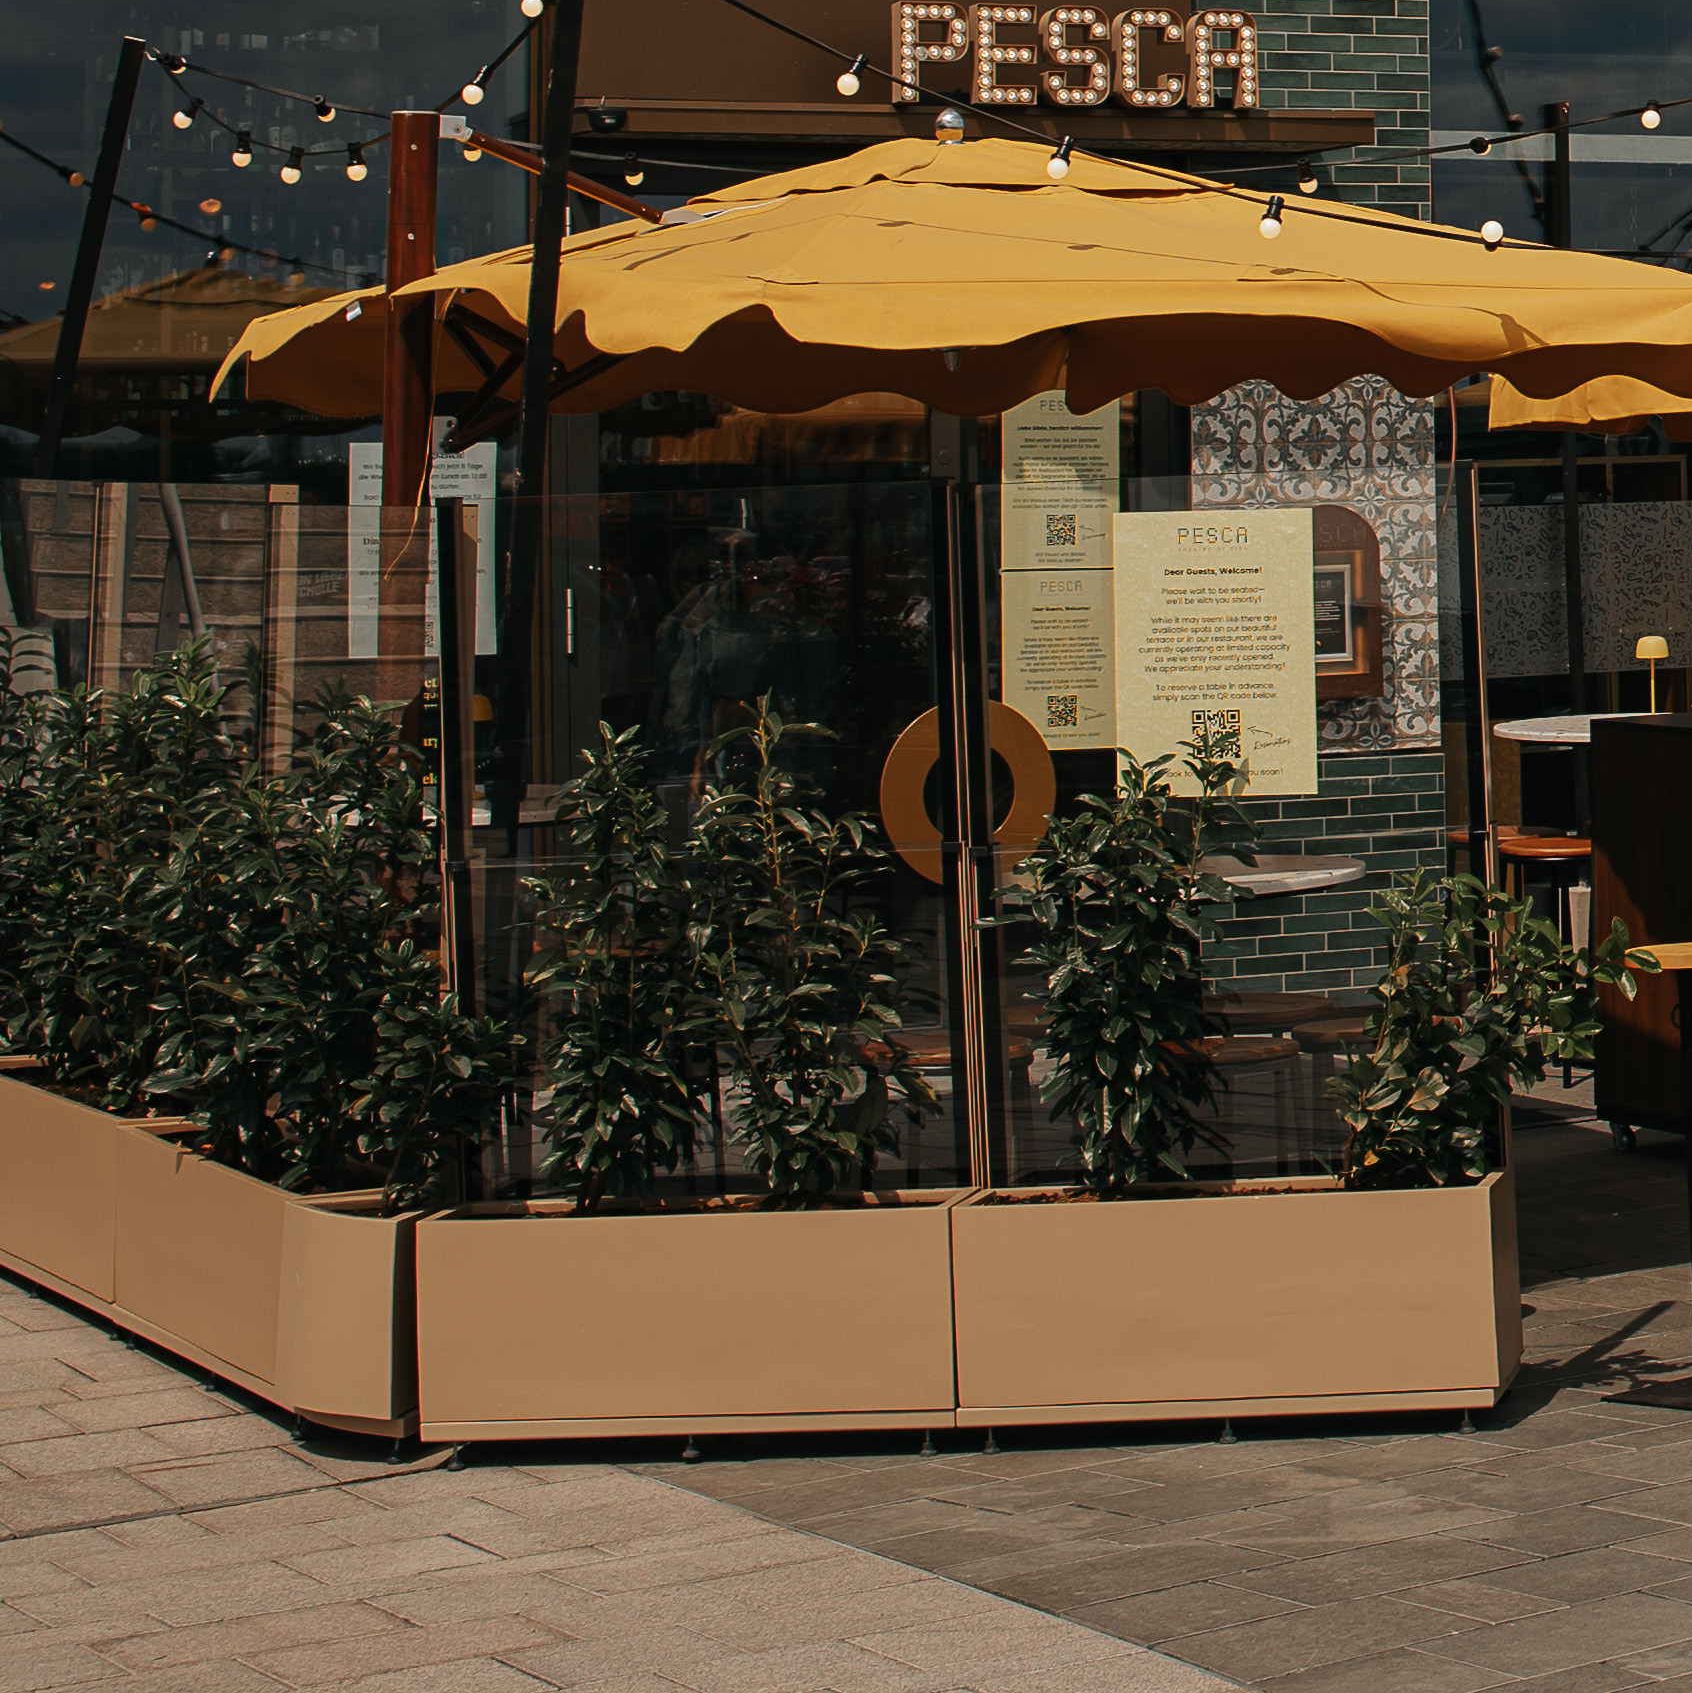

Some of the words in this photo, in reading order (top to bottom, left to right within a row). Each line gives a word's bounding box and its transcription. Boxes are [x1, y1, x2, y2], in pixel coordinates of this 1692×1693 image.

[891, 1, 1256, 109] PESCA
[1040, 400, 1066, 411] PES
[1177, 526, 1248, 544] PESCA
[1164, 568, 1184, 576] Dear
[1186, 568, 1218, 576] Guests,
[1219, 566, 1263, 575] Welcome!
[1040, 579, 1083, 593] PESCA
[1184, 597, 1195, 605] be
[1215, 598, 1231, 606] you
[1232, 595, 1262, 604] shortly!
[1182, 617, 1201, 625] may
[1241, 615, 1262, 623] there
[1152, 626, 1189, 634] available
[1241, 623, 1277, 632] beautiful
[1146, 636, 1175, 644] terrace
[1186, 635, 1195, 643] in
[1138, 646, 1174, 654] currently
[1175, 645, 1214, 654] operating
[1216, 644, 1225, 652] at
[1190, 654, 1208, 663] only
[1209, 653, 1241, 662] recently
[1159, 664, 1203, 674] appreciate
[1204, 664, 1222, 673] your
[1224, 661, 1286, 672] understanding!
[1206, 683, 1228, 691] table
[1229, 682, 1237, 690] in
[1153, 693, 1180, 703] simply
[1181, 693, 1201, 701] scan
[1217, 692, 1229, 701] QR
